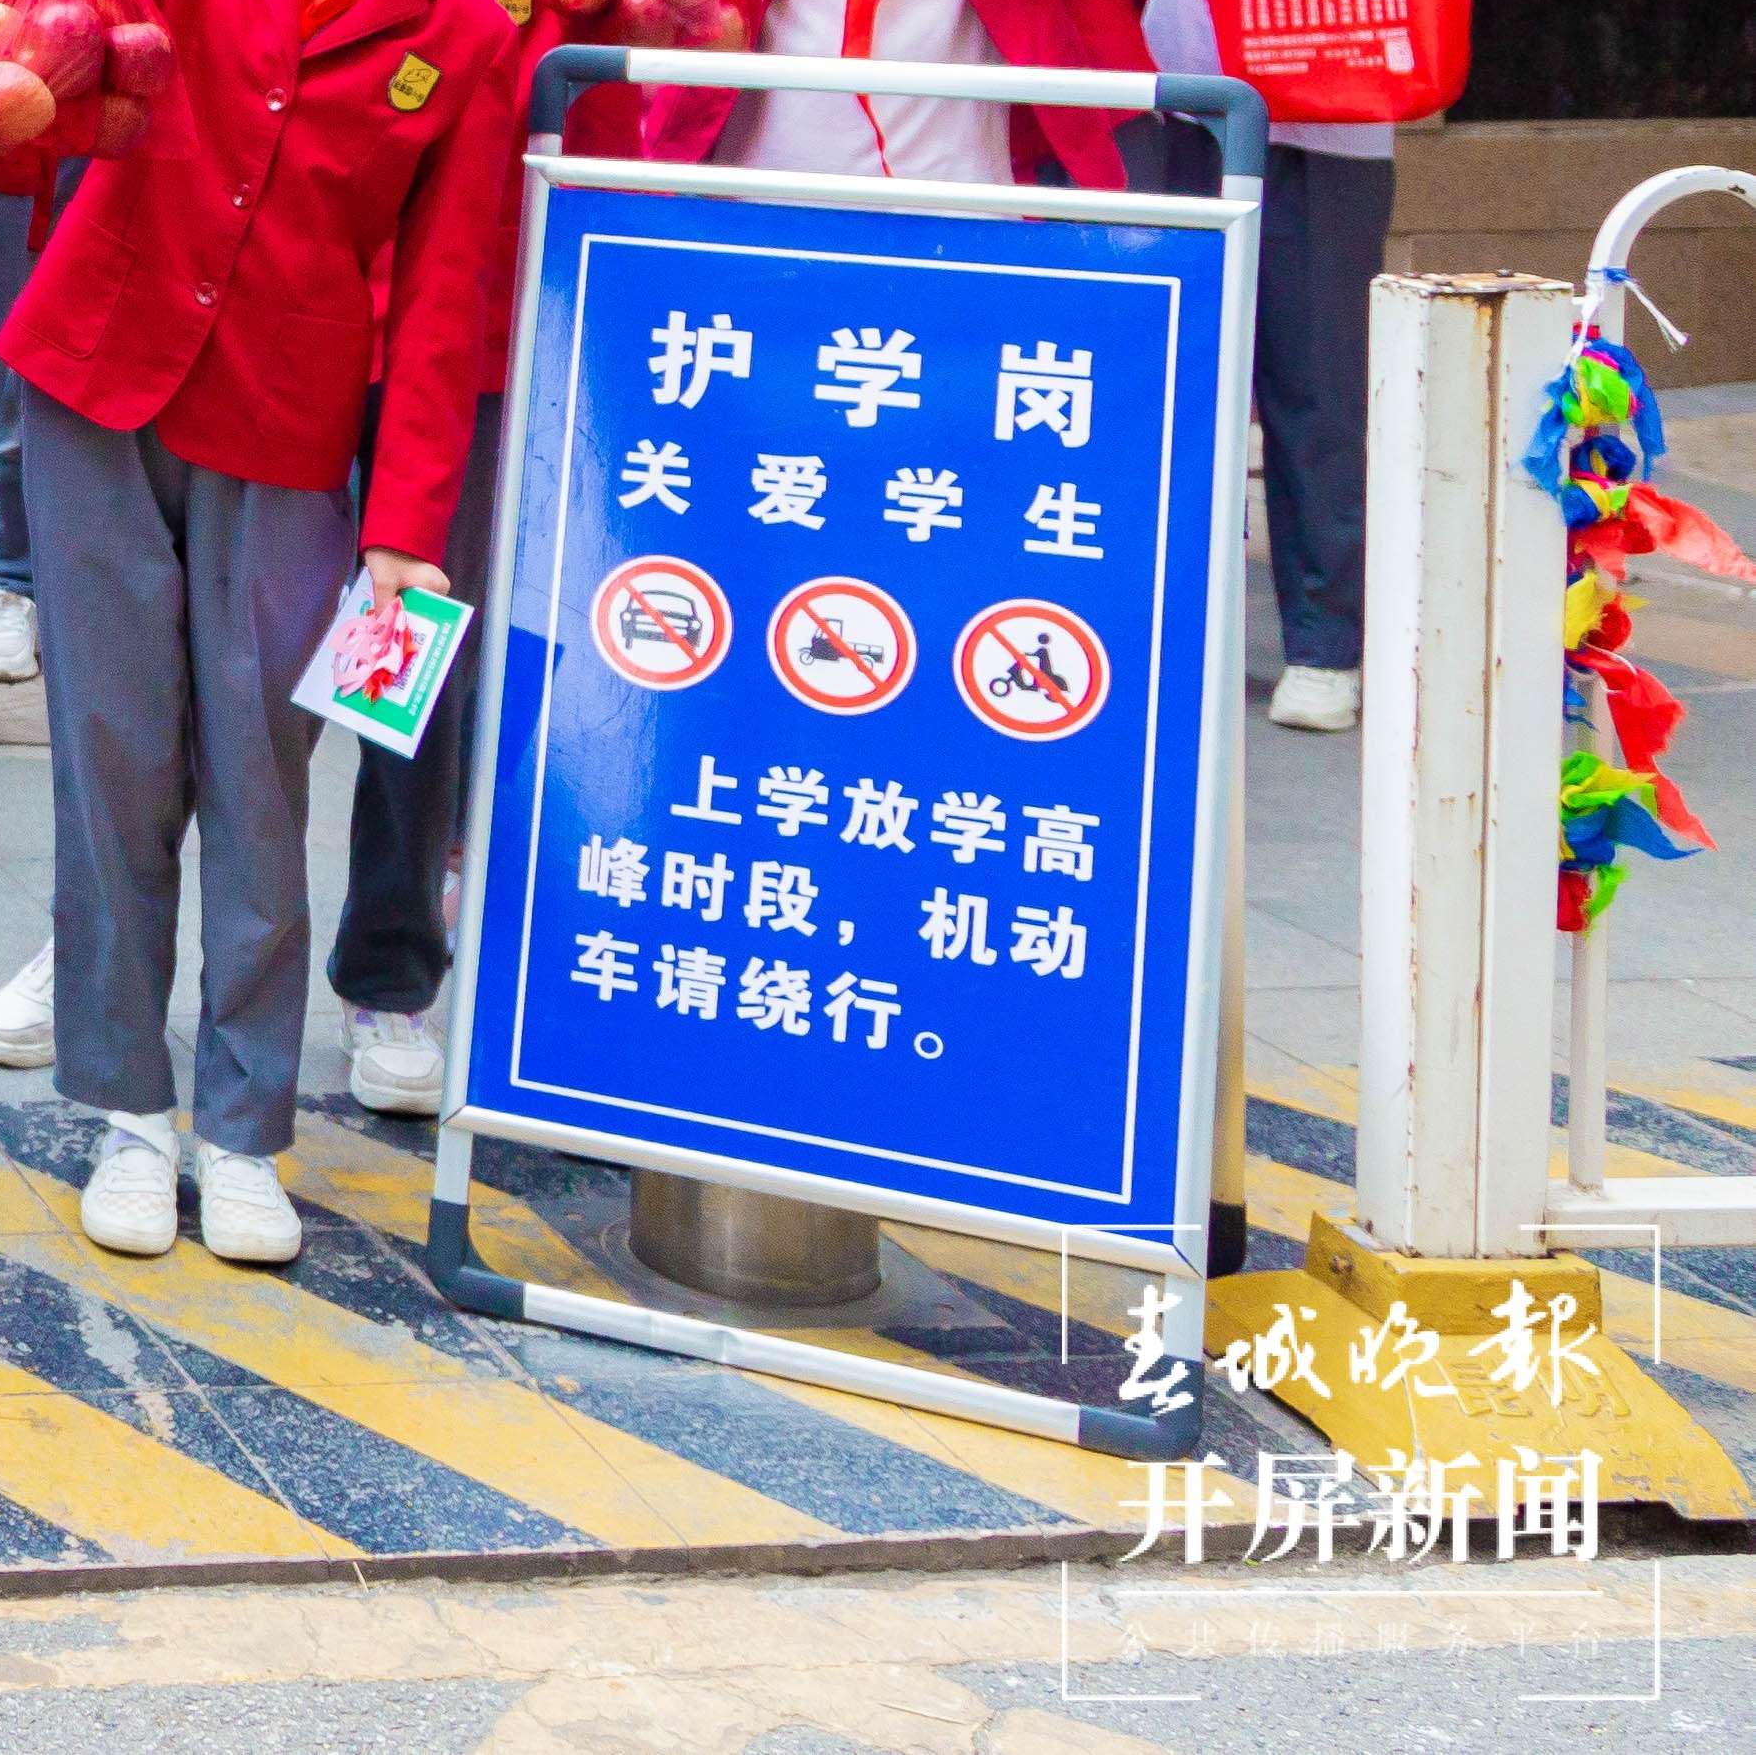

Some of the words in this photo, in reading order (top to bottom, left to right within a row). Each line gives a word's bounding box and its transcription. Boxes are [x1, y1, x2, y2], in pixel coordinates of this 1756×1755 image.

[647, 312, 1096, 449] 护学岗
[619, 439, 1106, 561] 关爱学生
[671, 754, 1102, 883] 上学放学高
[577, 834, 1088, 980] 峰时段，机动
[569, 928, 945, 1062] 车请绕行。
